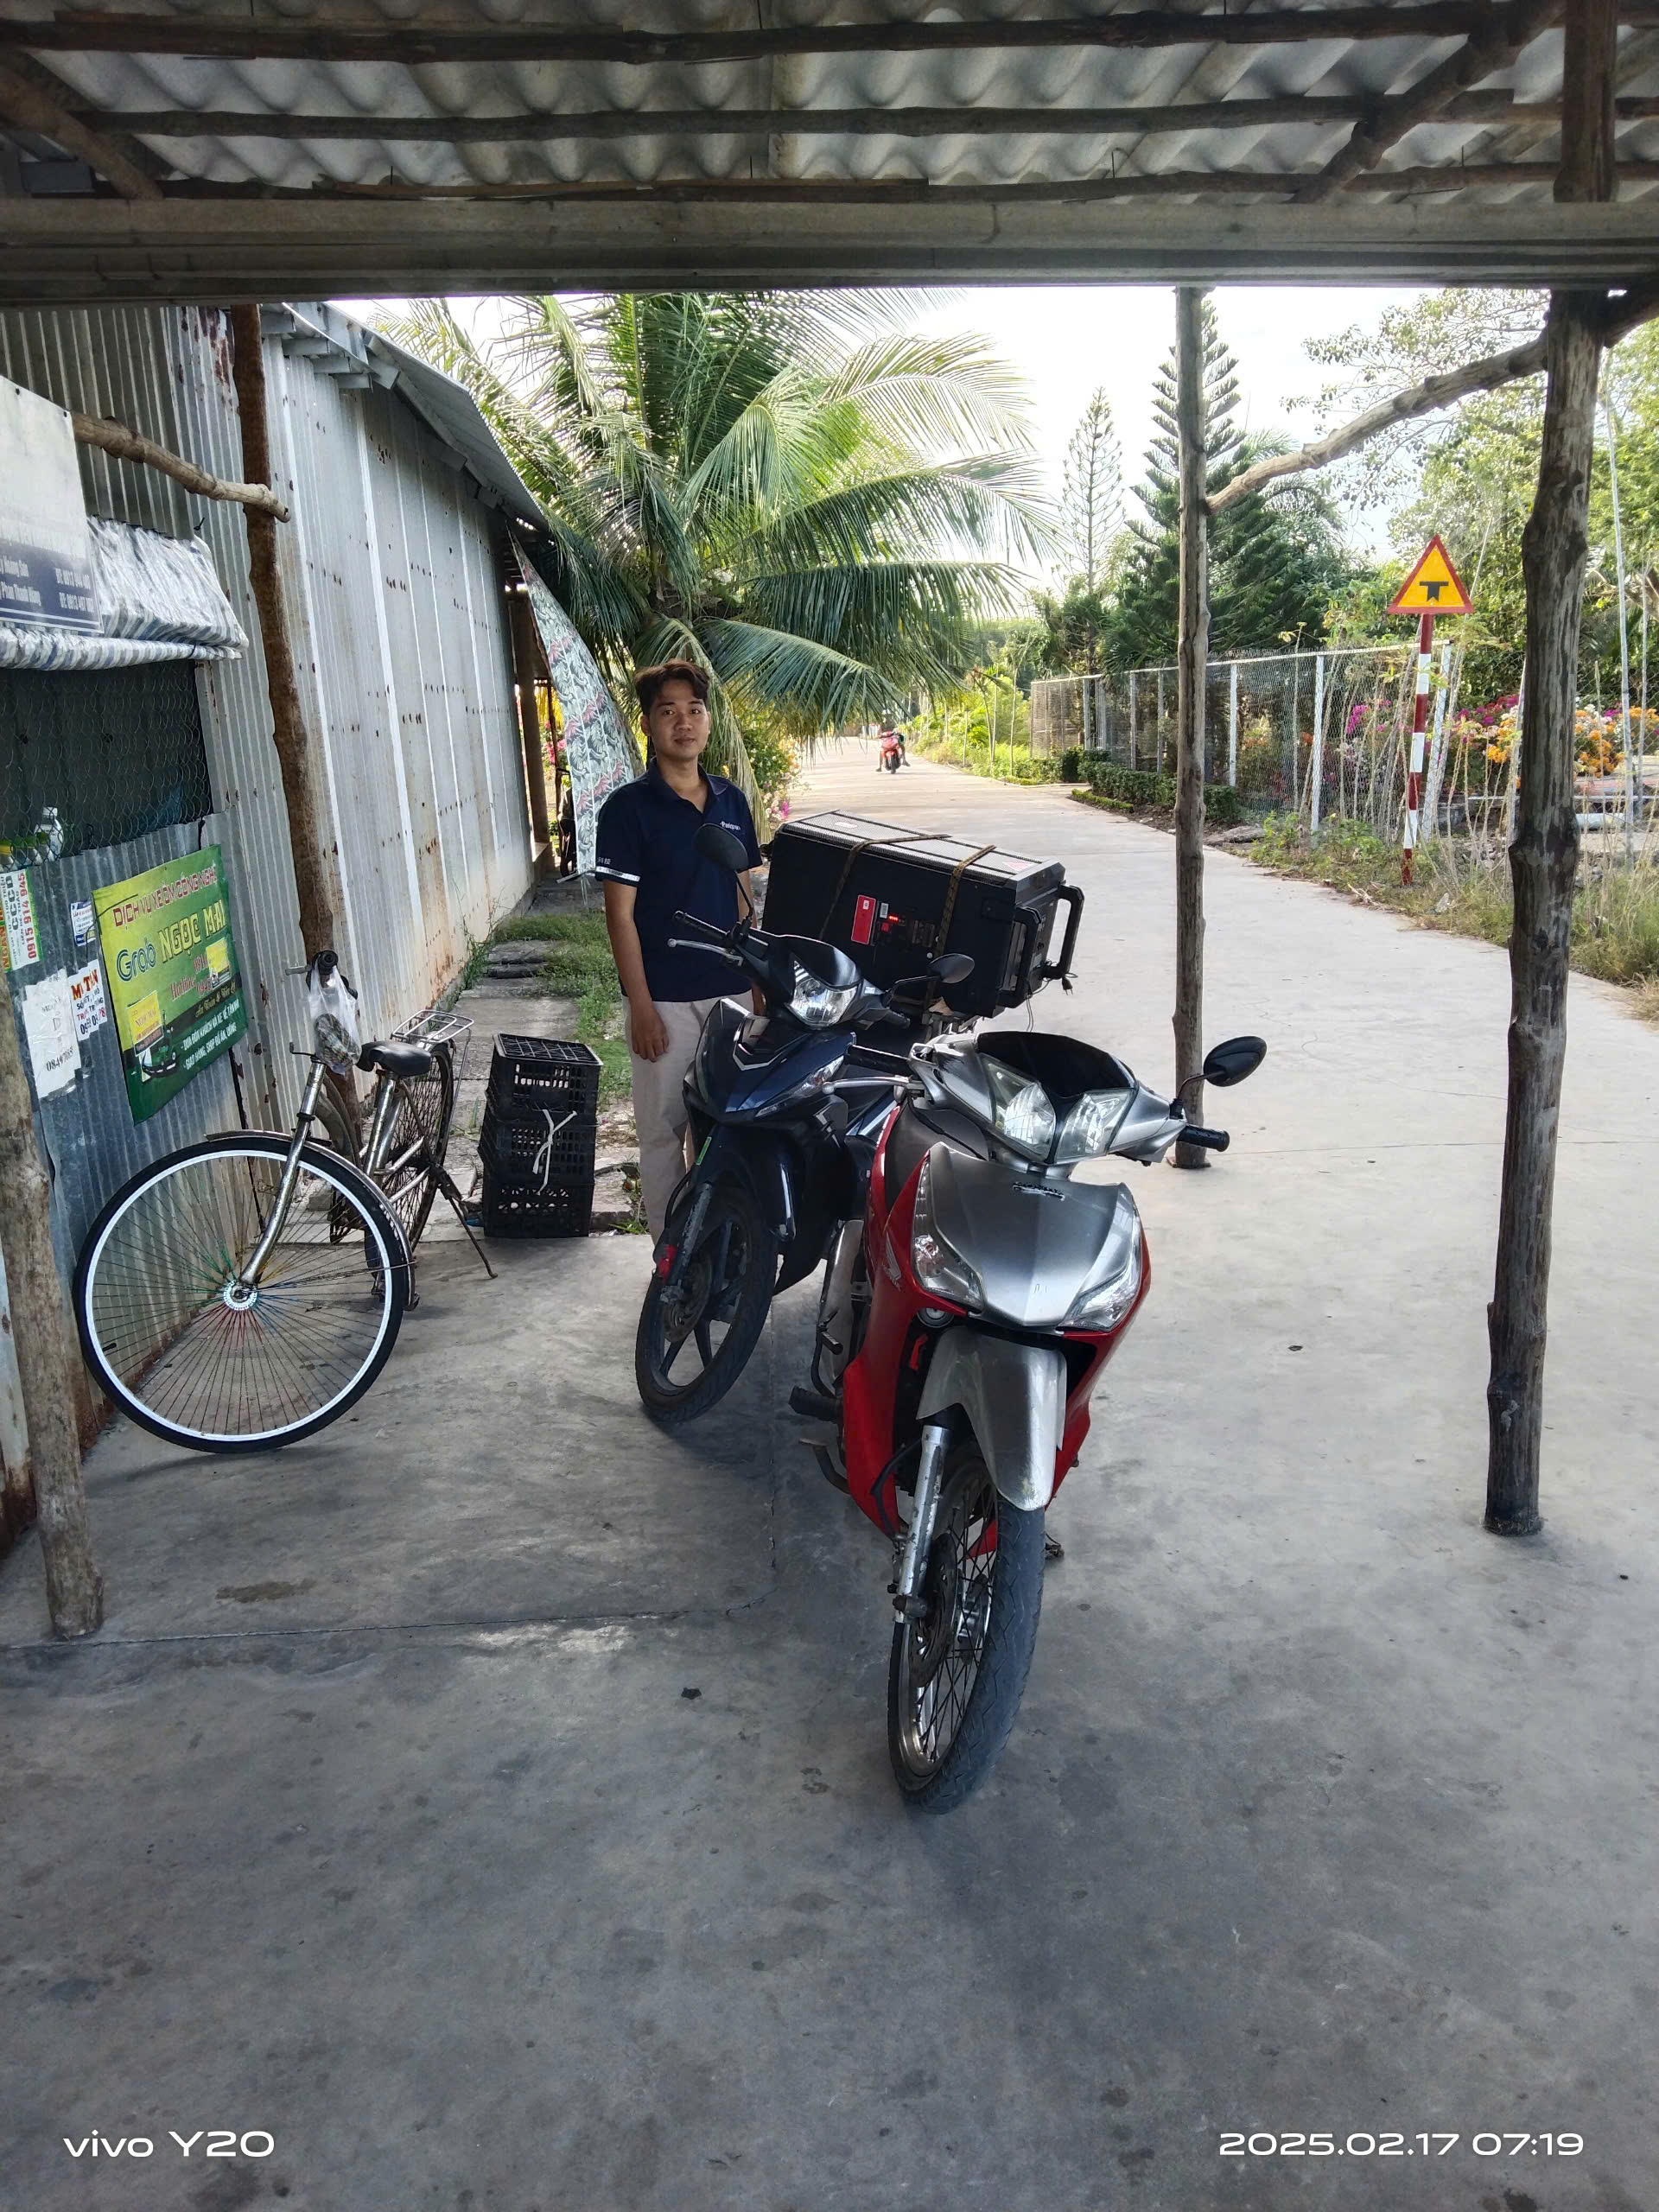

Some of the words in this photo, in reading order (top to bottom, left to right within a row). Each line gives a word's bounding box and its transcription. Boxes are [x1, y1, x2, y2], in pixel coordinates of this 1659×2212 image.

[5, 875, 19, 931] CCCD
[112, 901, 140, 930] DỊCH
[139, 896, 152, 918] VỤ
[152, 889, 163, 910] XE
[117, 938, 156, 982] Grab
[158, 913, 201, 963] NGỌC
[202, 899, 226, 939] MAI
